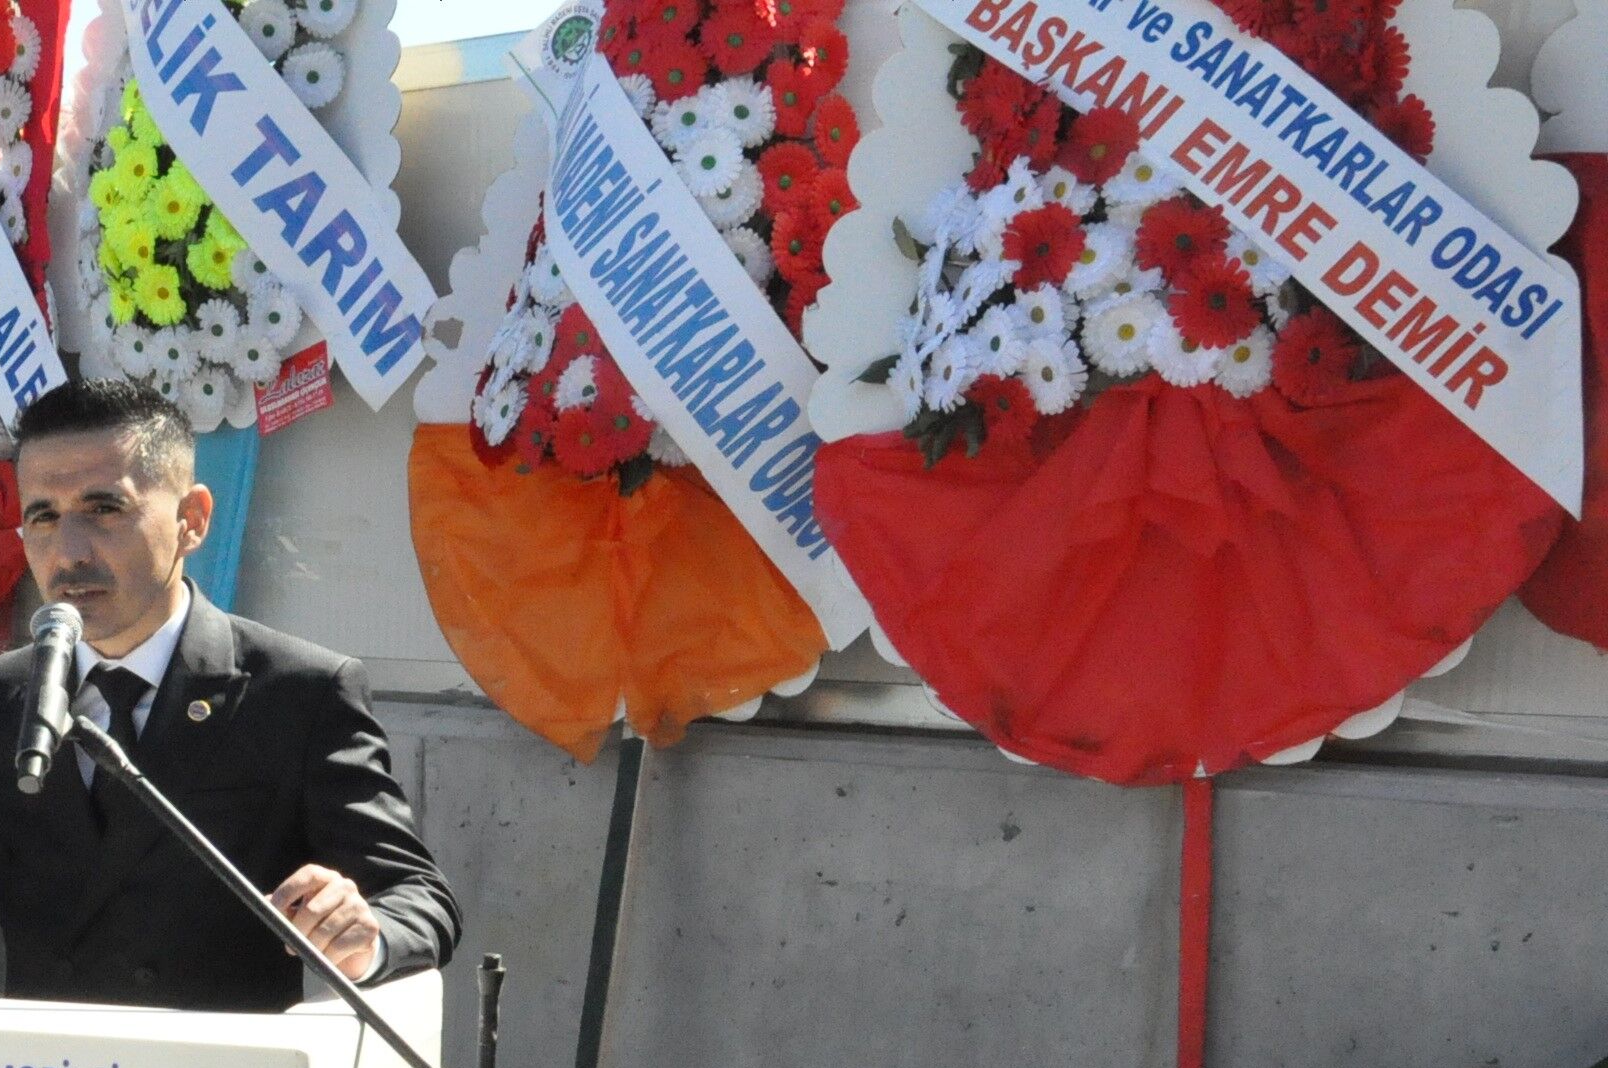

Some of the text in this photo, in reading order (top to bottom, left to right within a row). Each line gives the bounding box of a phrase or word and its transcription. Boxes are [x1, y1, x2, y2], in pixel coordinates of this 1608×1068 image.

[132, 0, 247, 137] ELİK
[230, 113, 423, 378] TARIM
[590, 211, 801, 472] SANATKARLAR
[964, 0, 1510, 411] BAŞKANI EMRE DEMİR
[1127, 0, 1564, 341] ve SANATKARLAR ODASI
